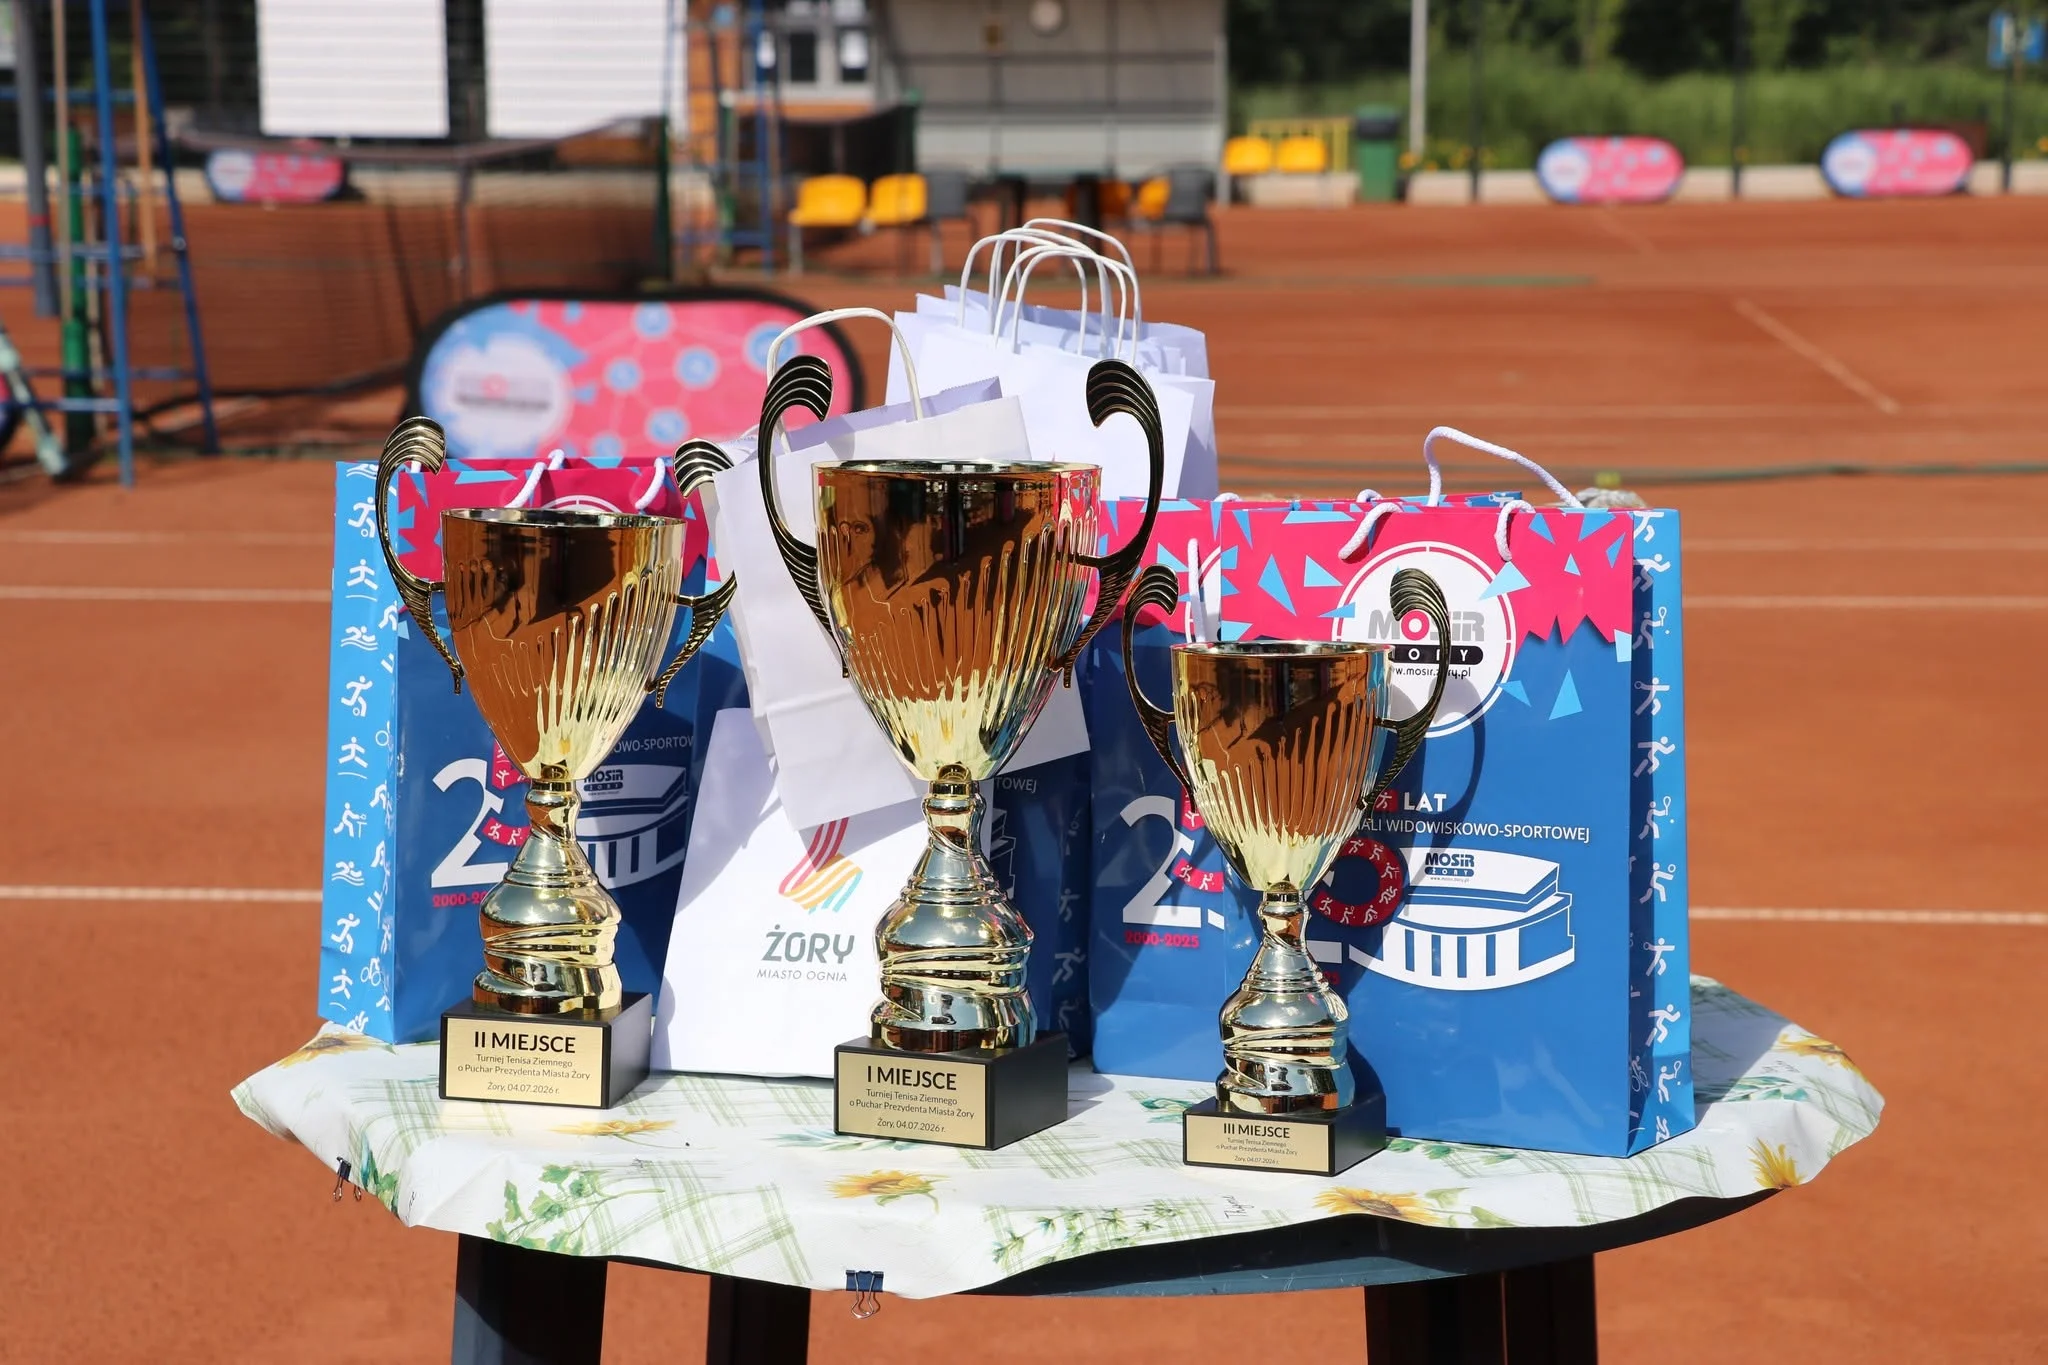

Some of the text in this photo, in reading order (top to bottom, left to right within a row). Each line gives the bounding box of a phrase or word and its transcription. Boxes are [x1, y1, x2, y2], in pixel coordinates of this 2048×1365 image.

[1404, 791, 1447, 812] LAT
[1357, 818, 1590, 844] ALI WIDOWISKOWO-SPORTOWEJ
[761, 924, 855, 964] ŻORY
[1124, 930, 1200, 949] 2000-2025
[757, 969, 847, 982] MIASTO OGNIA
[474, 1031, 576, 1053] II MIEJSCE
[476, 1054, 573, 1068] Turniej Tenisa Ziemnego
[465, 1064, 493, 1073] Puchar
[495, 1066, 541, 1077] Prezydenta
[542, 1069, 569, 1078] Miasta
[867, 1065, 957, 1090] I MIEJSCE
[507, 1083, 554, 1094] 04.07.2026
[866, 1089, 958, 1106] Turniej Tenisa Ziemnego
[856, 1099, 882, 1109] Puchar
[884, 1102, 927, 1113] Prezydenta
[928, 1106, 954, 1116] Miasta
[896, 1120, 940, 1132] 04.07.2026
[1223, 1123, 1290, 1139] III MIEJSCE
[1245, 1138, 1261, 1146] Tenisa
[1262, 1140, 1287, 1148] Ziemnego
